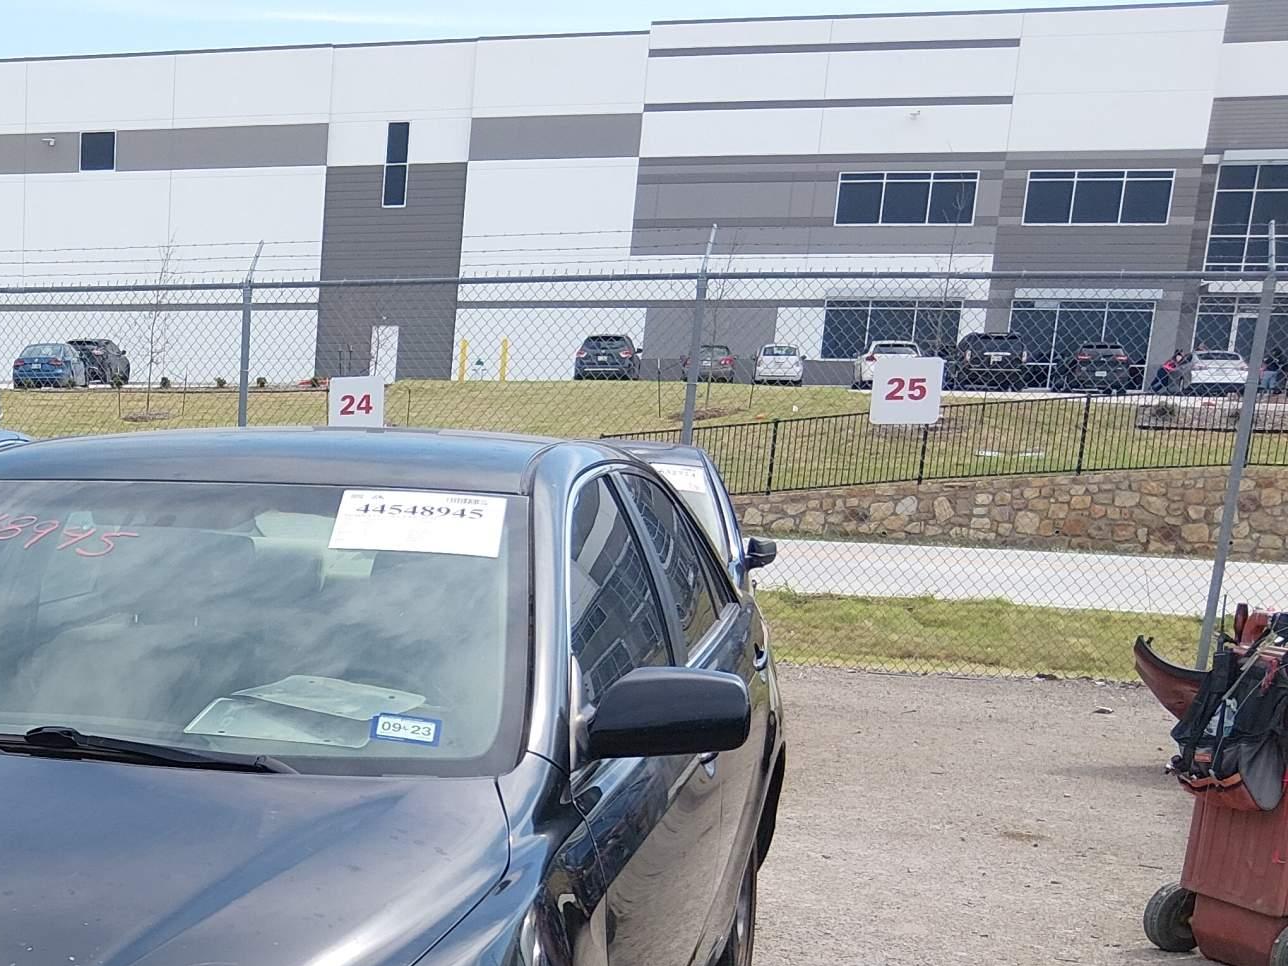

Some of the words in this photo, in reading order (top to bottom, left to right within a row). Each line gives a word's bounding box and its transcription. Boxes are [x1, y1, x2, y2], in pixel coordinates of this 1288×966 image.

[885, 377, 927, 401] 25
[339, 394, 373, 416] 24
[355, 503, 484, 520] 44548945
